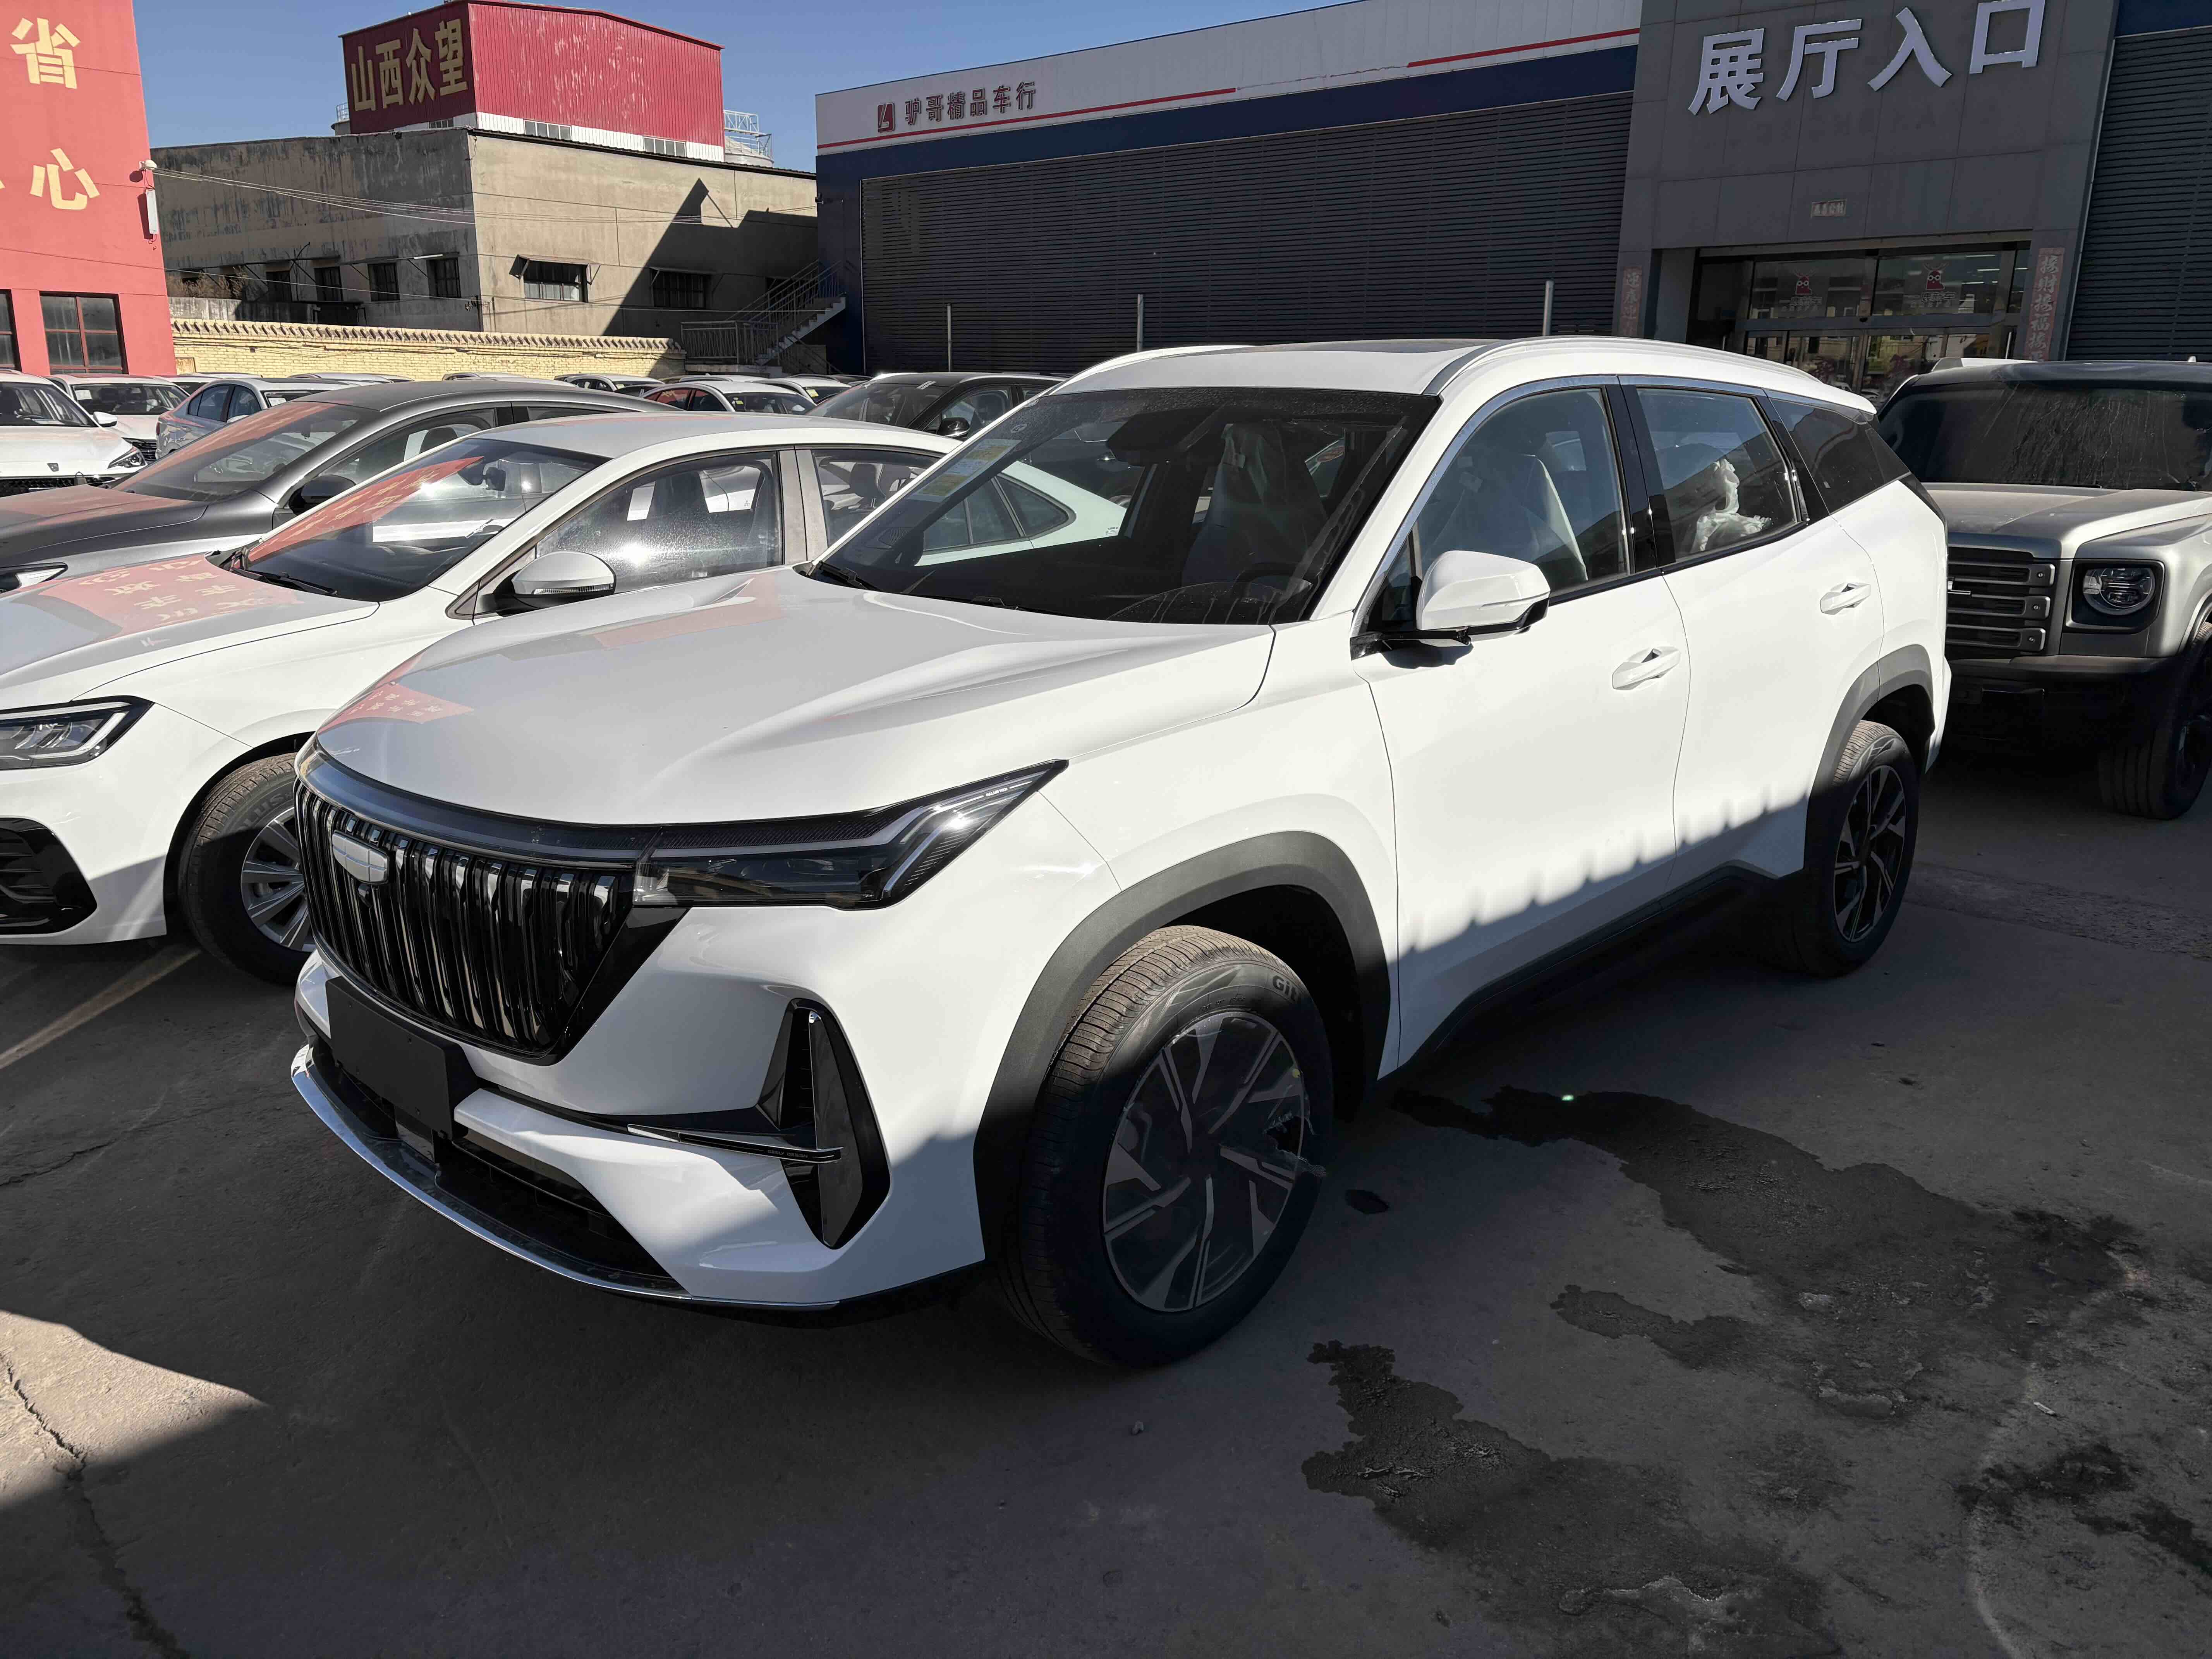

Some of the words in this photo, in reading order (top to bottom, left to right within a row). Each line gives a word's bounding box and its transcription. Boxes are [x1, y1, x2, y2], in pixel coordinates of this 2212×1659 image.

[350, 18, 468, 112] 山西众望
[1688, 0, 2045, 115] 展厅入口
[904, 81, 1036, 126] 驴哥精品车行
[1273, 975, 1299, 1002] Git
